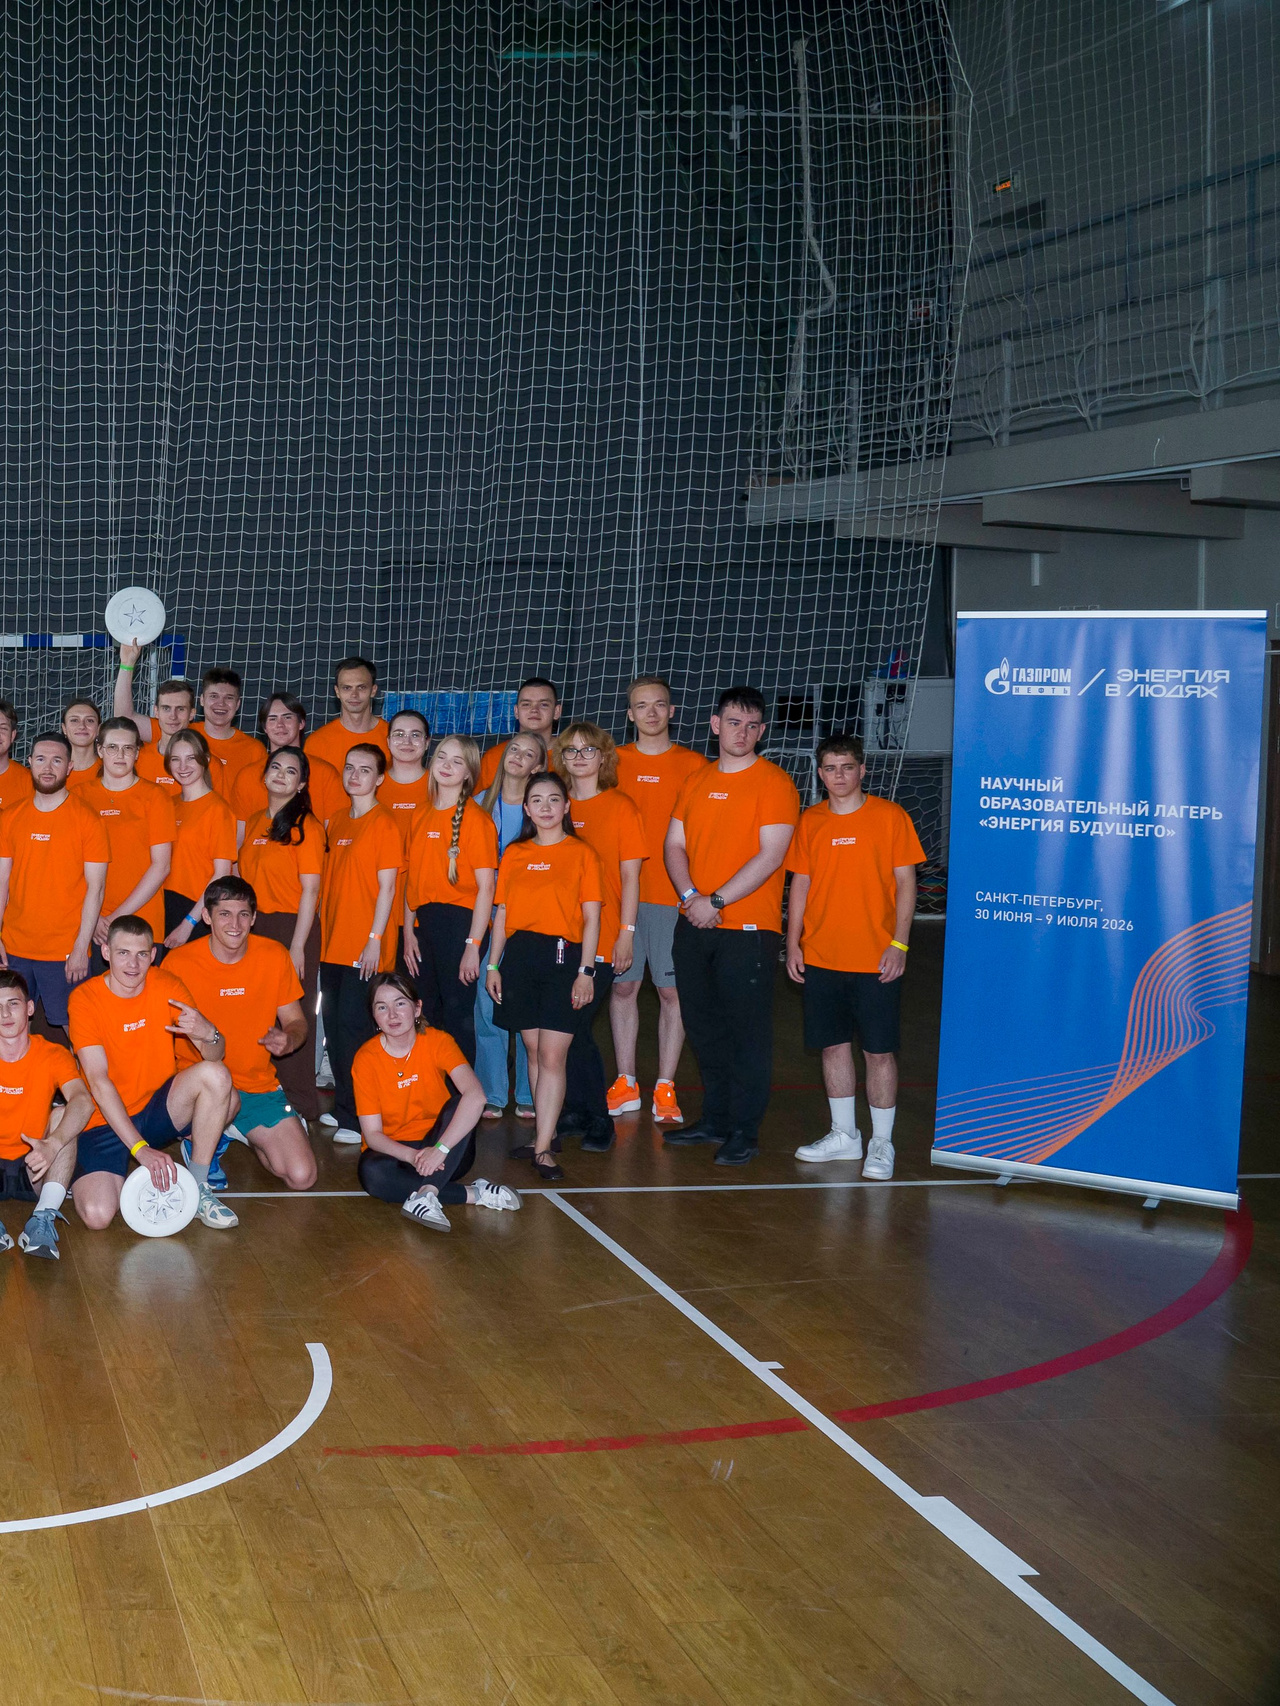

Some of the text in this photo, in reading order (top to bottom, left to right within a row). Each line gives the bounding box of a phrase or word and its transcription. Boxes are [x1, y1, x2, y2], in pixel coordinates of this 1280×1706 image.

[1013, 668, 1071, 682] ГАЗПРОМ
[1117, 669, 1229, 683] ЭНЕРГИЯ
[1014, 686, 1068, 695] НЕФТЬ
[1105, 684, 1217, 698] В ЛЮДЯХ
[981, 777, 1063, 792] НАУЧНЫЙ
[980, 796, 1222, 819] ОБРАЗОВАТЕЛЬНЫЙ ЛАГЕРЬ
[979, 816, 1176, 839] «ЭНЕРГИЯ БУДУЩЕГО»
[976, 891, 1103, 912] САНКТ-ПЕТЕРБУРГ,
[975, 909, 989, 919] 30
[994, 911, 1032, 923] ИЮНЯ
[1046, 914, 1053, 924] 9
[1058, 915, 1097, 928] ИЮЛЯ
[1102, 919, 1133, 931] 2026
